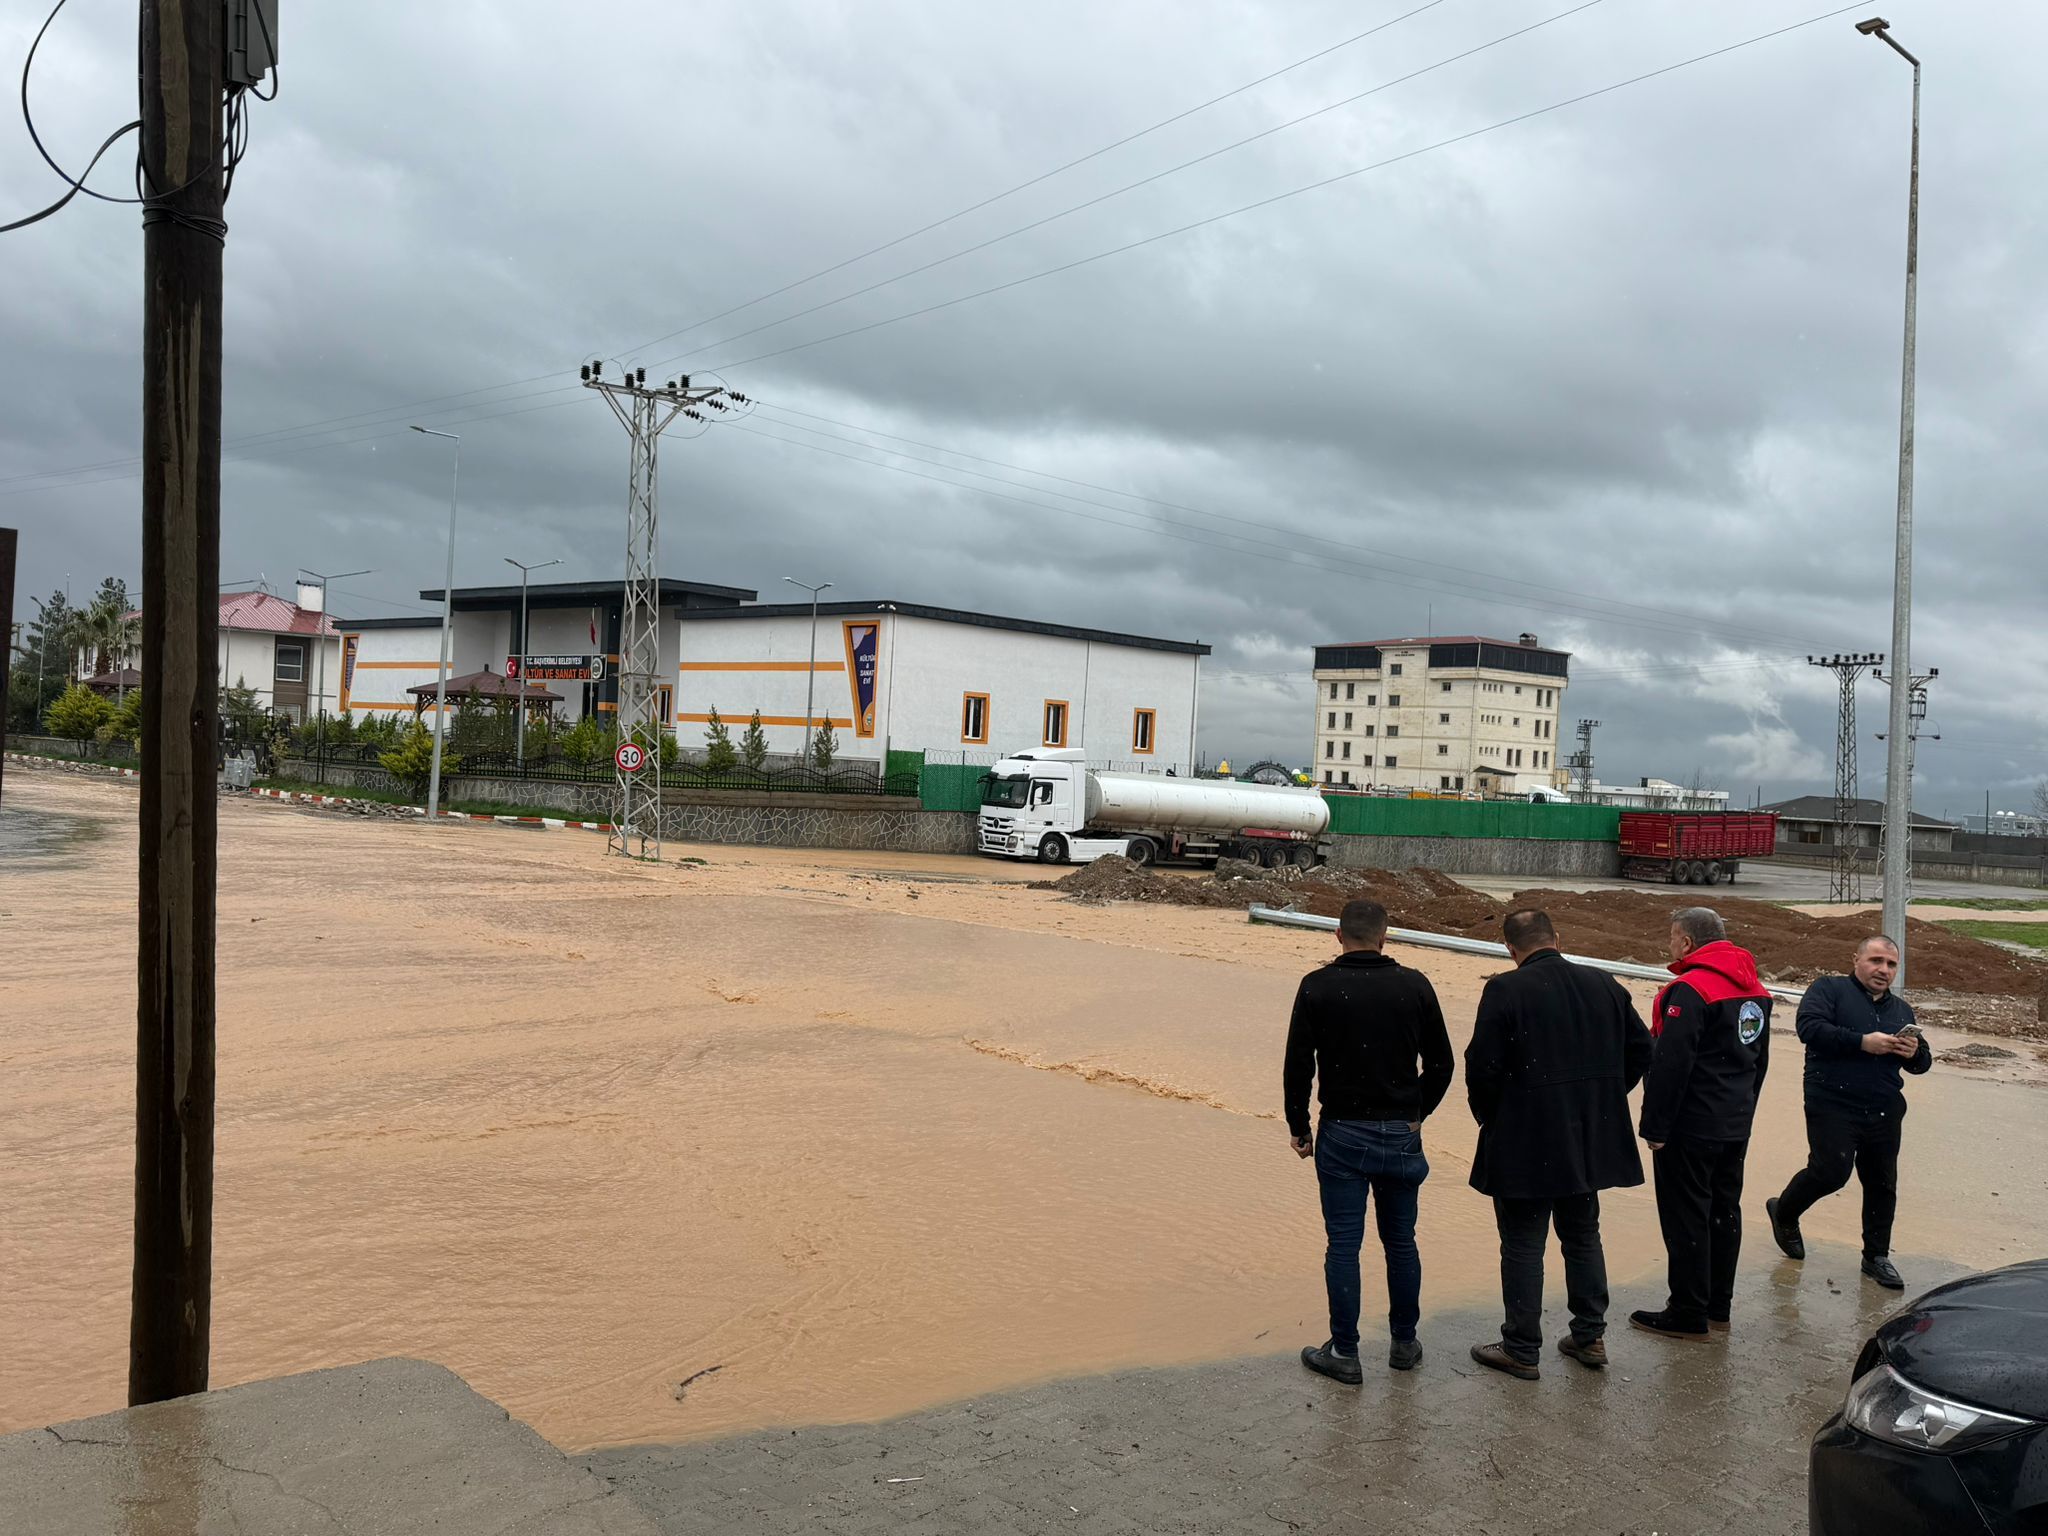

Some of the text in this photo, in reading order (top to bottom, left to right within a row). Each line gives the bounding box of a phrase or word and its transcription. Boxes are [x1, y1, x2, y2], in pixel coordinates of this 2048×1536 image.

[545, 668, 555, 679] VE
[556, 668, 577, 679] SANAT
[621, 750, 639, 764] 30
